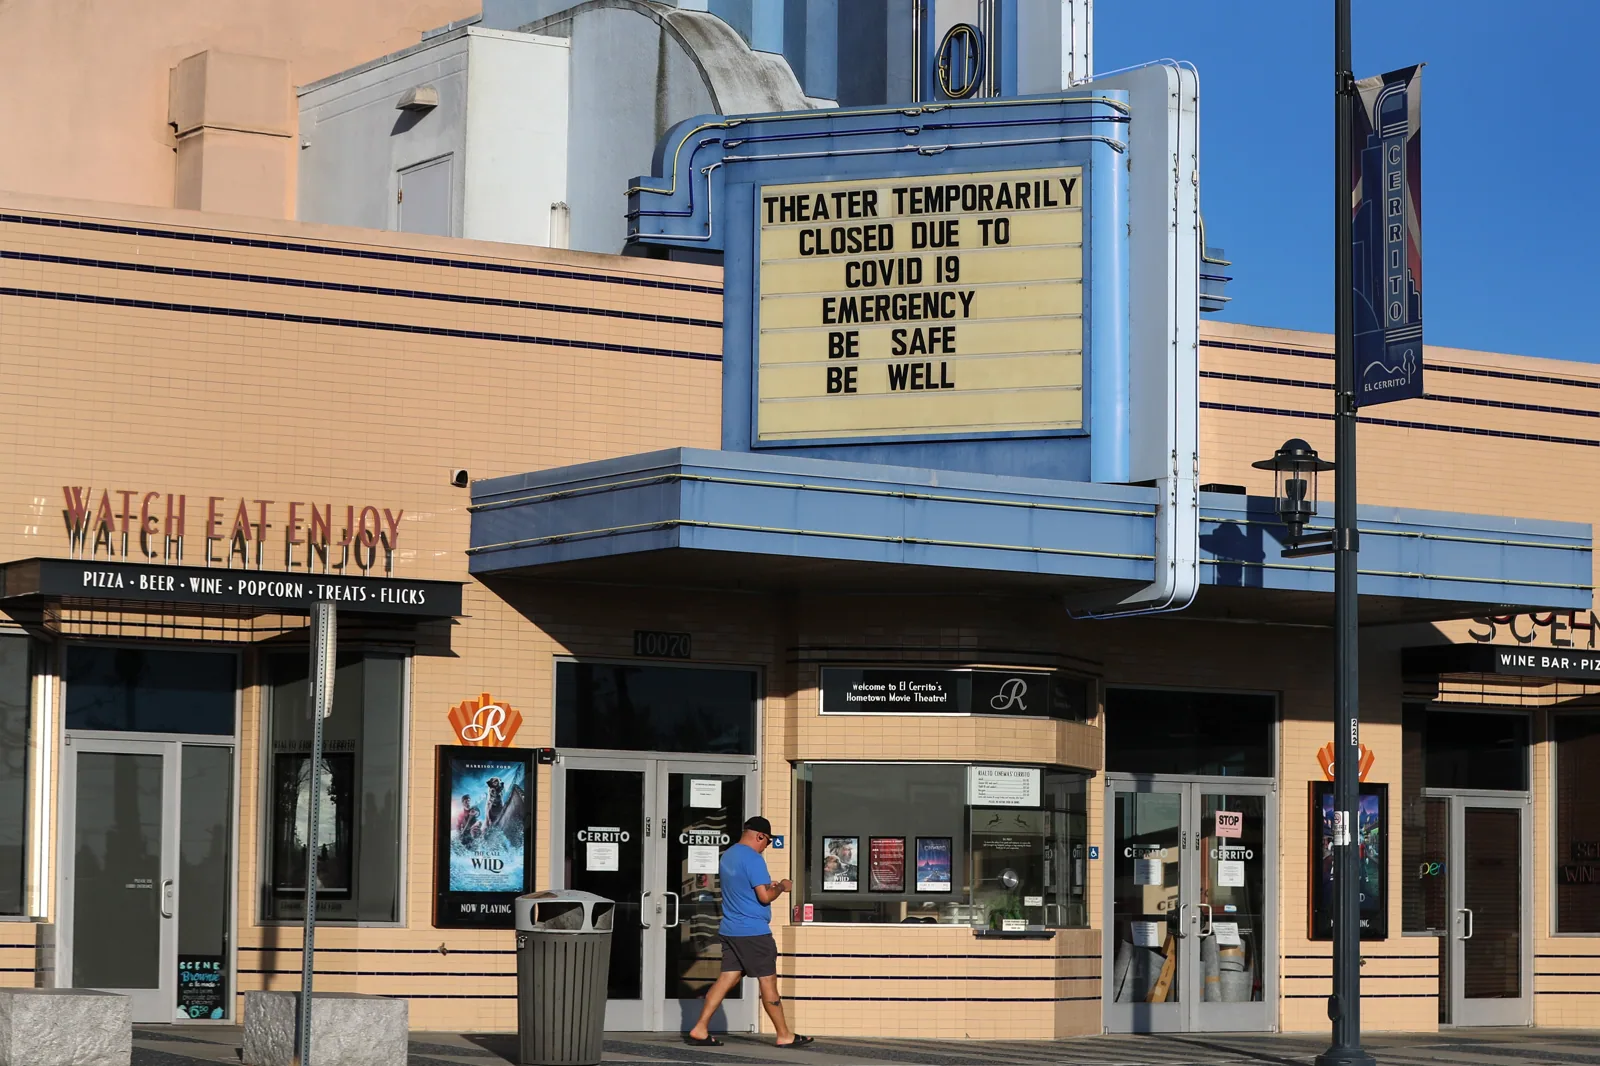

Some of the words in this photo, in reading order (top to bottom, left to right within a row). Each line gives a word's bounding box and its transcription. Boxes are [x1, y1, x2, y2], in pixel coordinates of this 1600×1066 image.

[763, 189, 878, 223] THEATER
[892, 178, 1077, 215] TEMPORARILY
[799, 223, 894, 256] CLOSED
[912, 220, 960, 250] DUE
[977, 217, 1010, 247] TO
[1388, 144, 1403, 322] CERRITO
[845, 257, 923, 289] COVID
[936, 255, 960, 283] 19
[822, 291, 976, 325] EMERGENCY
[828, 331, 860, 359] BE
[891, 326, 957, 356] SAFE
[826, 366, 858, 394] BE
[888, 362, 955, 391] WELL
[1364, 383, 1373, 392] EL
[1373, 377, 1406, 390] CERRITO
[62, 486, 186, 537] WATCH
[208, 496, 275, 541] EAT
[288, 502, 404, 550] ENJOY
[83, 571, 124, 589] PIZZA
[139, 575, 175, 592] BEER
[189, 577, 223, 595] WINE
[238, 580, 303, 599] POPCORN
[317, 584, 367, 602] TREATS
[380, 588, 426, 606] FLICKS
[635, 632, 691, 657] 10070
[1500, 654, 1536, 667] WINE
[1541, 656, 1570, 669] BAR
[888, 683, 897, 691] to
[899, 681, 906, 691] El
[908, 681, 942, 691] Cerrito's
[846, 692, 887, 702] Hometown
[888, 692, 911, 702] Movie
[913, 692, 947, 702] Theatre!
[1218, 815, 1240, 826] STOP
[577, 829, 630, 842] CERRITO
[678, 833, 731, 846] CERRITO
[471, 858, 504, 873] WILD
[460, 903, 477, 913] NOW
[480, 904, 512, 914] PLAYING
[180, 962, 221, 970] SCENE
